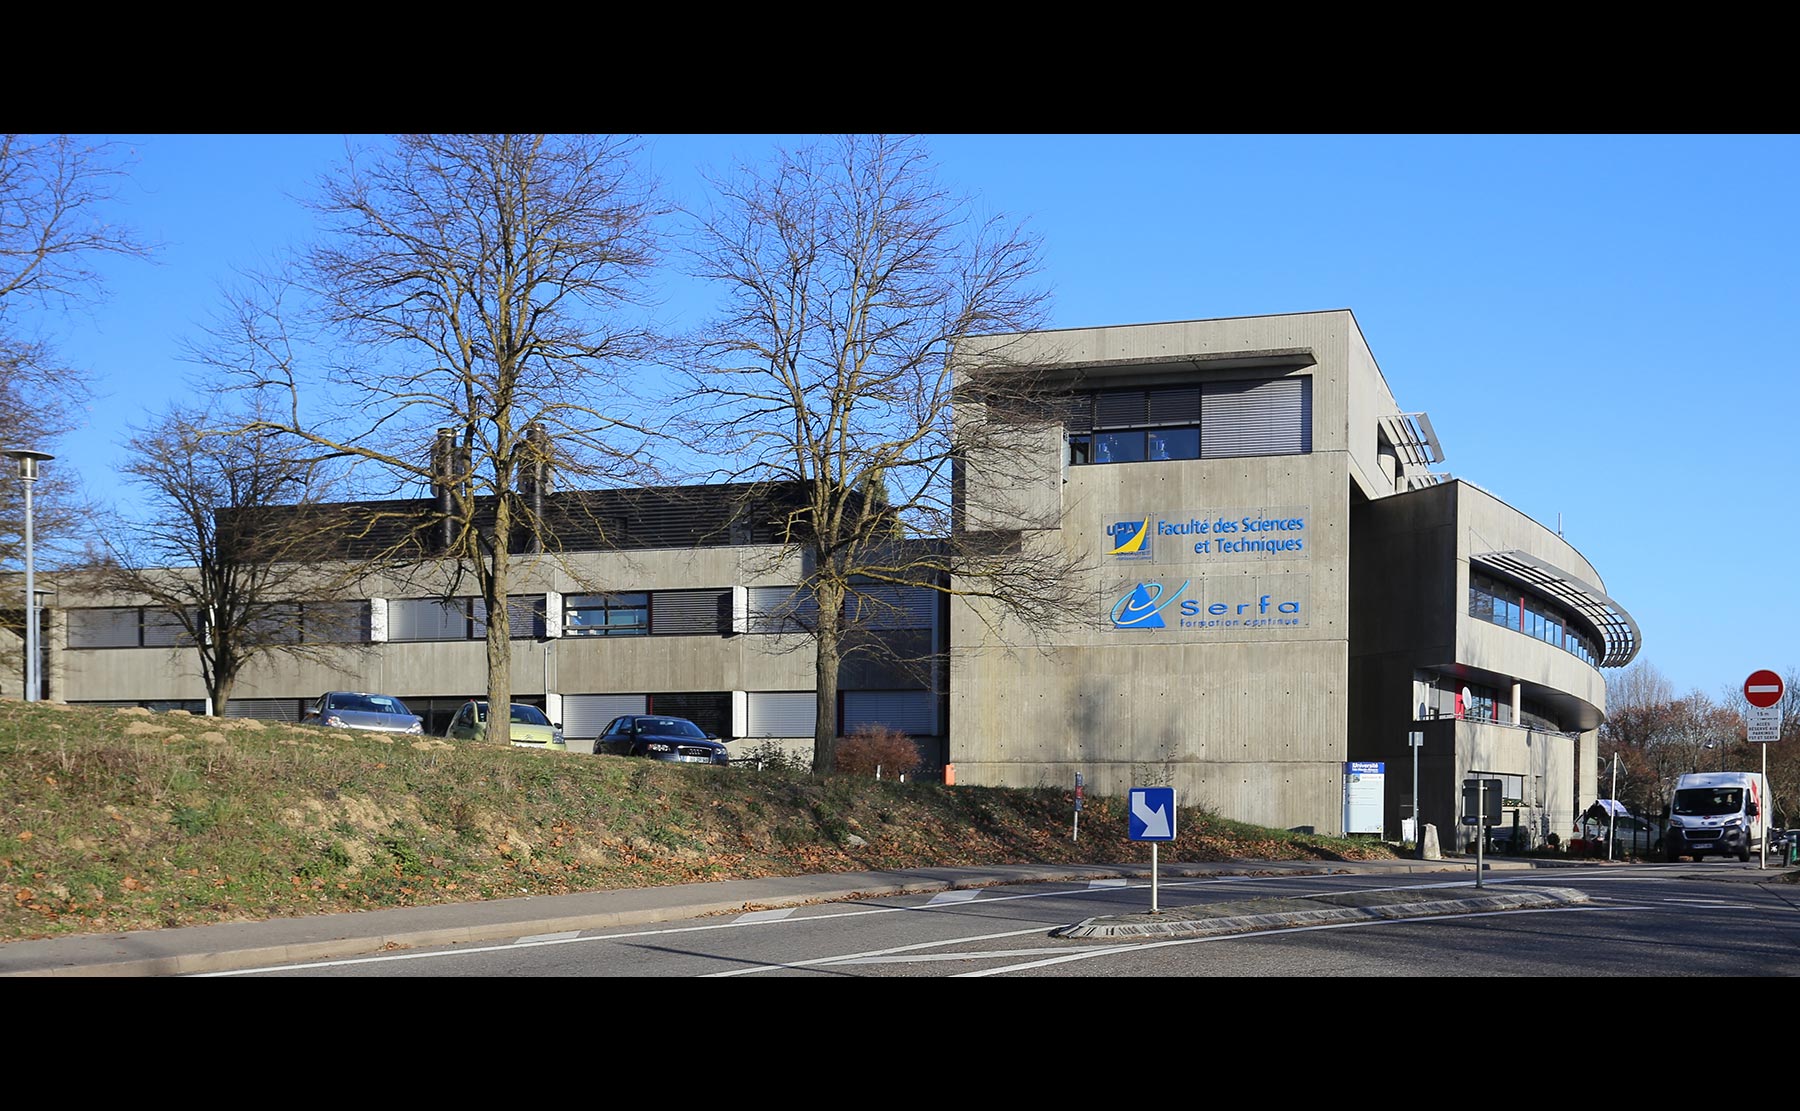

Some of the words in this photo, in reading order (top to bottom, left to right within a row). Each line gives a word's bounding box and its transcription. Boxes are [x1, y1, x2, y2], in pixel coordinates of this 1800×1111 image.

[1158, 518, 1210, 535] Faculté
[1213, 517, 1239, 533] des
[1242, 516, 1304, 533] Sciences
[1194, 540, 1210, 554] et
[1215, 535, 1303, 555] Techniques
[1180, 594, 1300, 616] Serfa
[1245, 617, 1299, 626] continue
